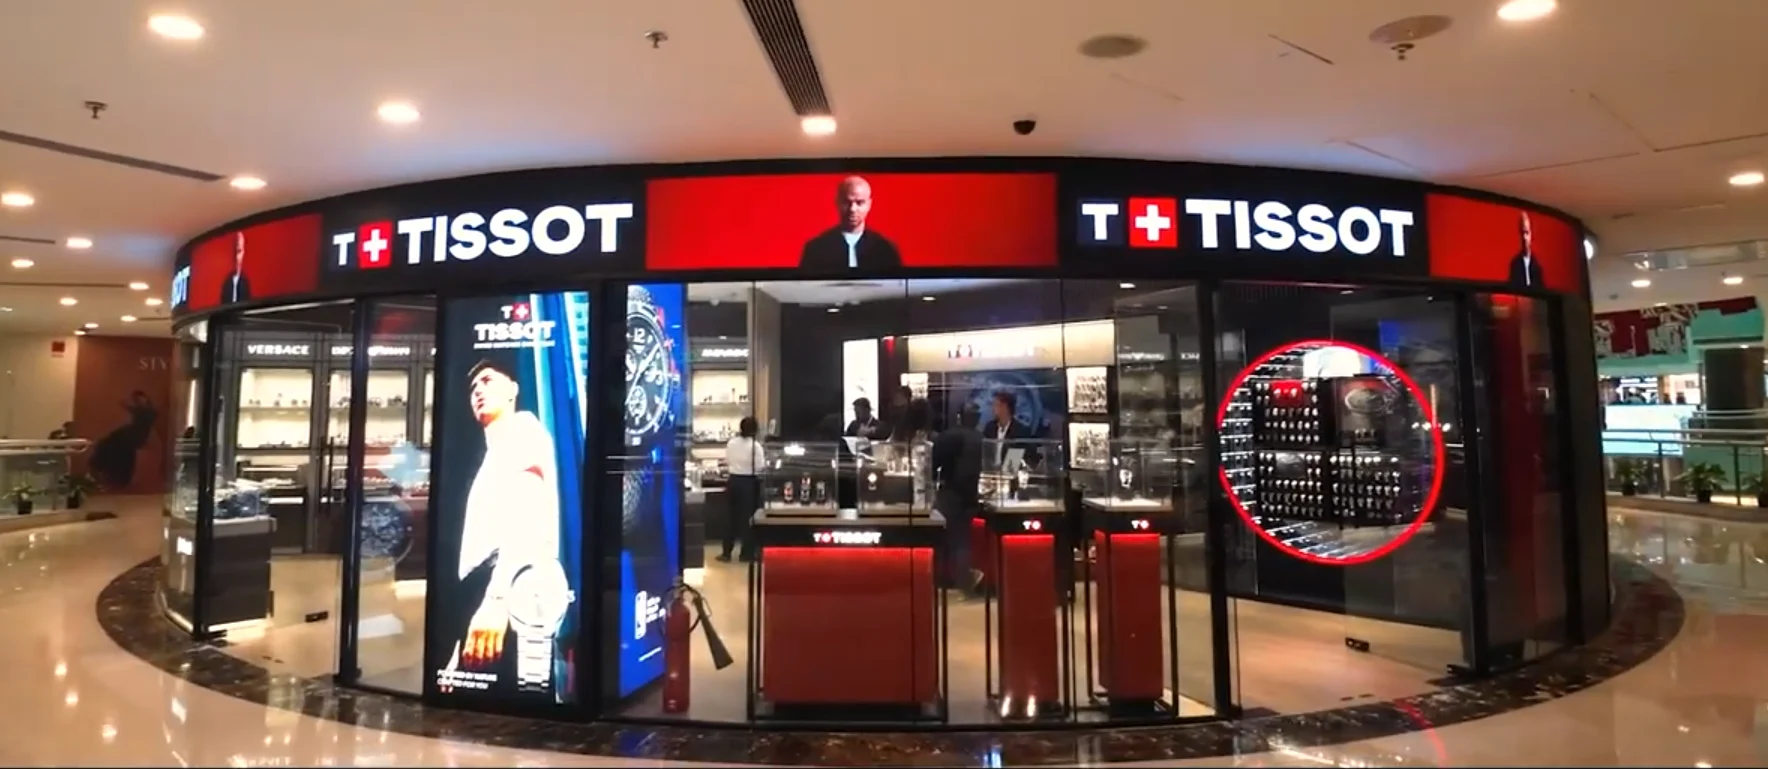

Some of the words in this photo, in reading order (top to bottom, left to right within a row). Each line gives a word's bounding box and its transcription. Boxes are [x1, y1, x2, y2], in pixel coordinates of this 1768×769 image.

[398, 203, 633, 264] TISSOT
[1185, 198, 1414, 256] TISSOT
[474, 321, 556, 341] TISSOT
[248, 344, 310, 356] VERSACE
[831, 531, 882, 544] TISSOT
